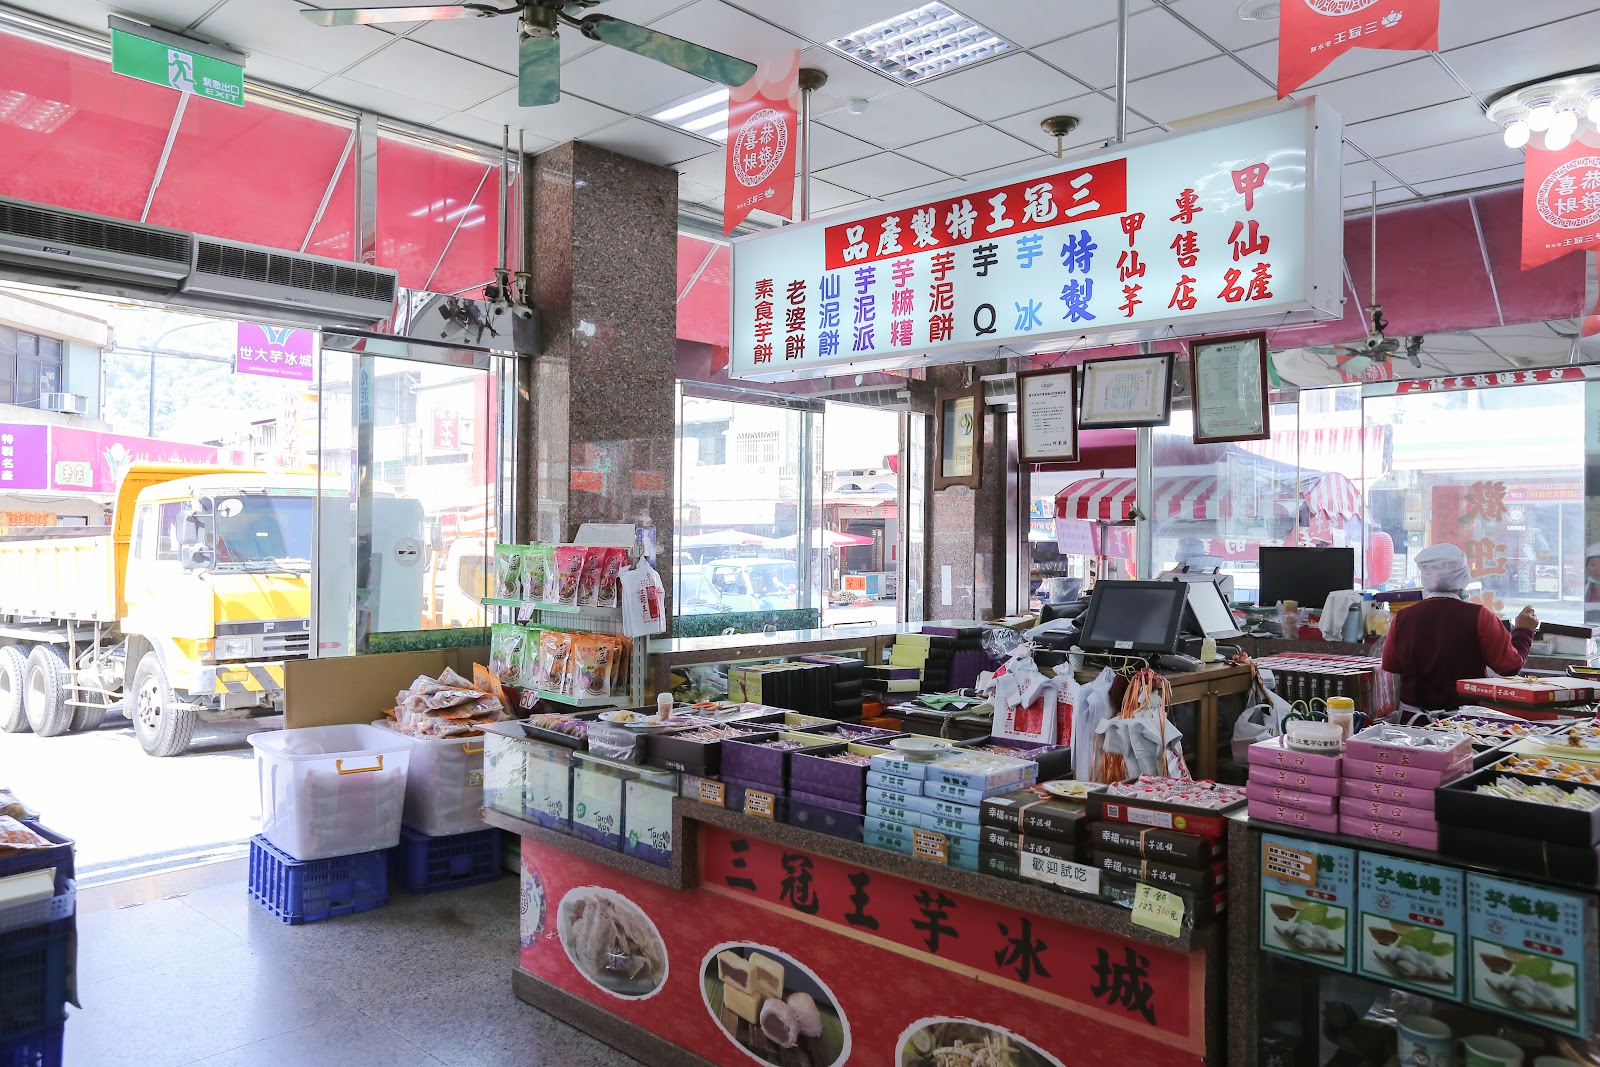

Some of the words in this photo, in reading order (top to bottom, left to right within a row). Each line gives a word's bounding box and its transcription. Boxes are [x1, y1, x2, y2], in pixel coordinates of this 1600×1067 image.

[202, 77, 240, 95] 緊急出口
[205, 88, 238, 101] EXIT
[1116, 212, 1147, 318] 甲仙芋
[1168, 187, 1203, 311] 專售店
[972, 242, 998, 337] 芋Q
[1014, 233, 1044, 332] 芋冰
[1059, 229, 1097, 322] 特製
[818, 273, 840, 357] 仙泥餅
[852, 266, 876, 351] 芋泥派
[929, 251, 955, 343] 芋泥餅
[753, 278, 773, 365] 素食芋餅
[785, 279, 807, 361] 老婆餅
[240, 345, 313, 368] 世大芋冰城
[1, 433, 14, 481] 特製名產
[62, 464, 84, 483] 老店
[544, 796, 563, 811] Taro
[593, 810, 614, 826] Taro
[647, 827, 671, 844] Taro
[1148, 840, 1173, 853] 芋泥餅
[1032, 857, 1087, 882] 歡迎試吃
[1151, 868, 1176, 883] 芋泥餅
[1143, 887, 1167, 904] 芋餅
[1156, 906, 1178, 921] 300元
[726, 839, 1157, 1026] 三冠王芋冰城
